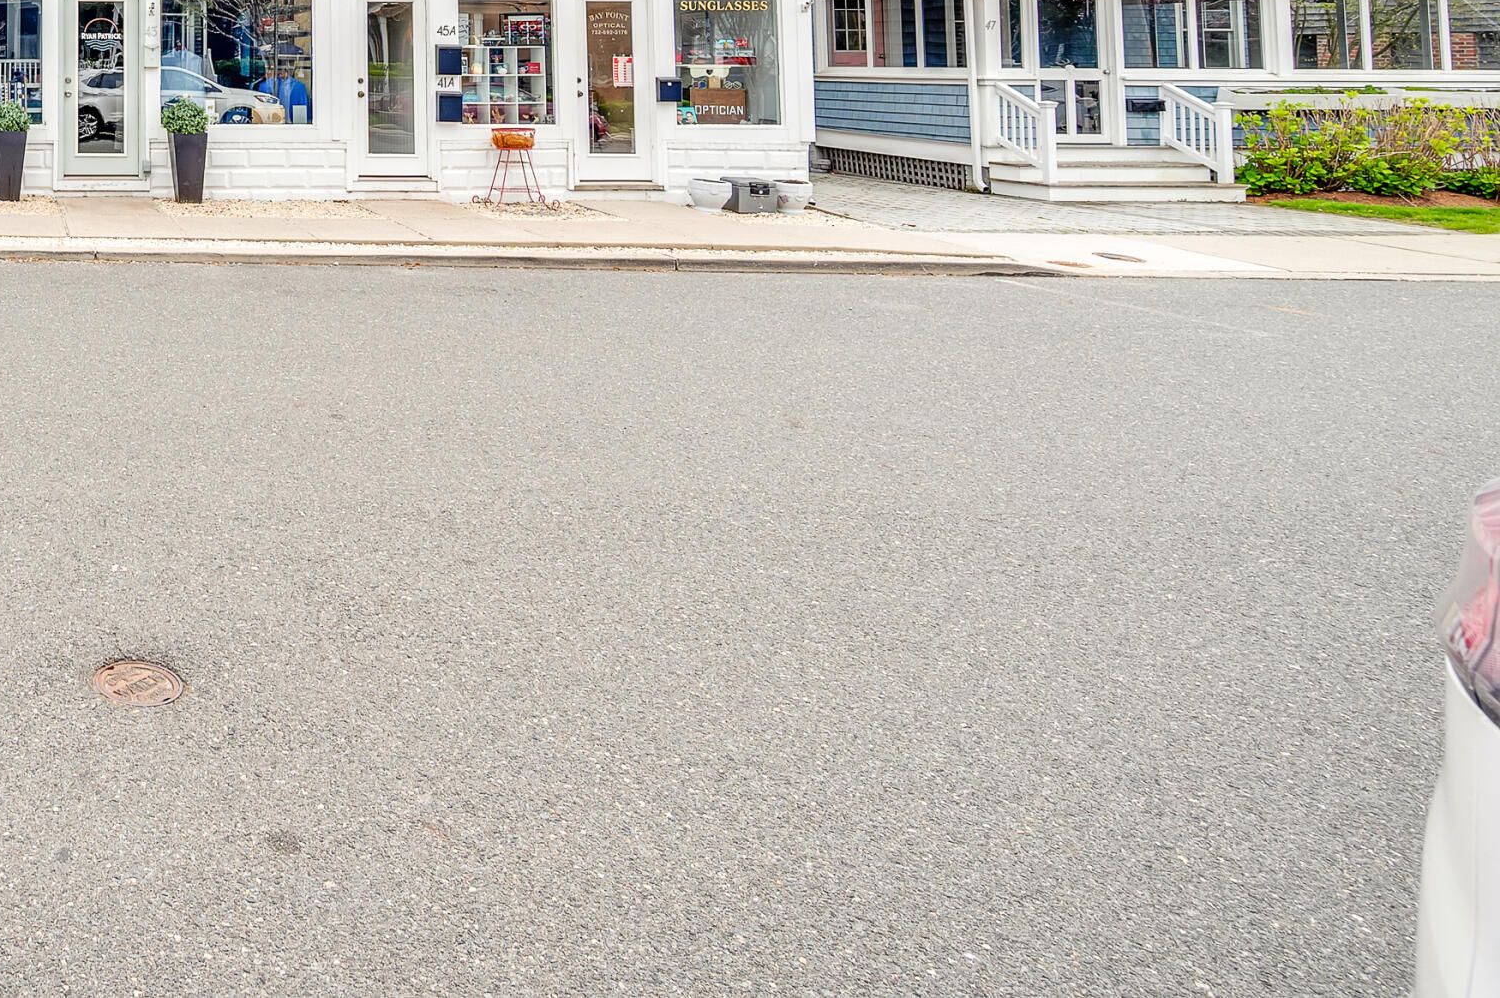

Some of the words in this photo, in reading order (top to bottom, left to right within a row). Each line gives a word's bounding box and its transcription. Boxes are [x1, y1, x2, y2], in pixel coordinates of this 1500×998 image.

[679, 0, 769, 11] SUNGLASSES
[588, 12, 604, 22] BAY
[605, 11, 629, 21] POINT
[437, 25, 456, 36] 45A
[985, 20, 996, 30] 47
[438, 77, 455, 88] 41A
[694, 105, 744, 115] OPTICIAN
